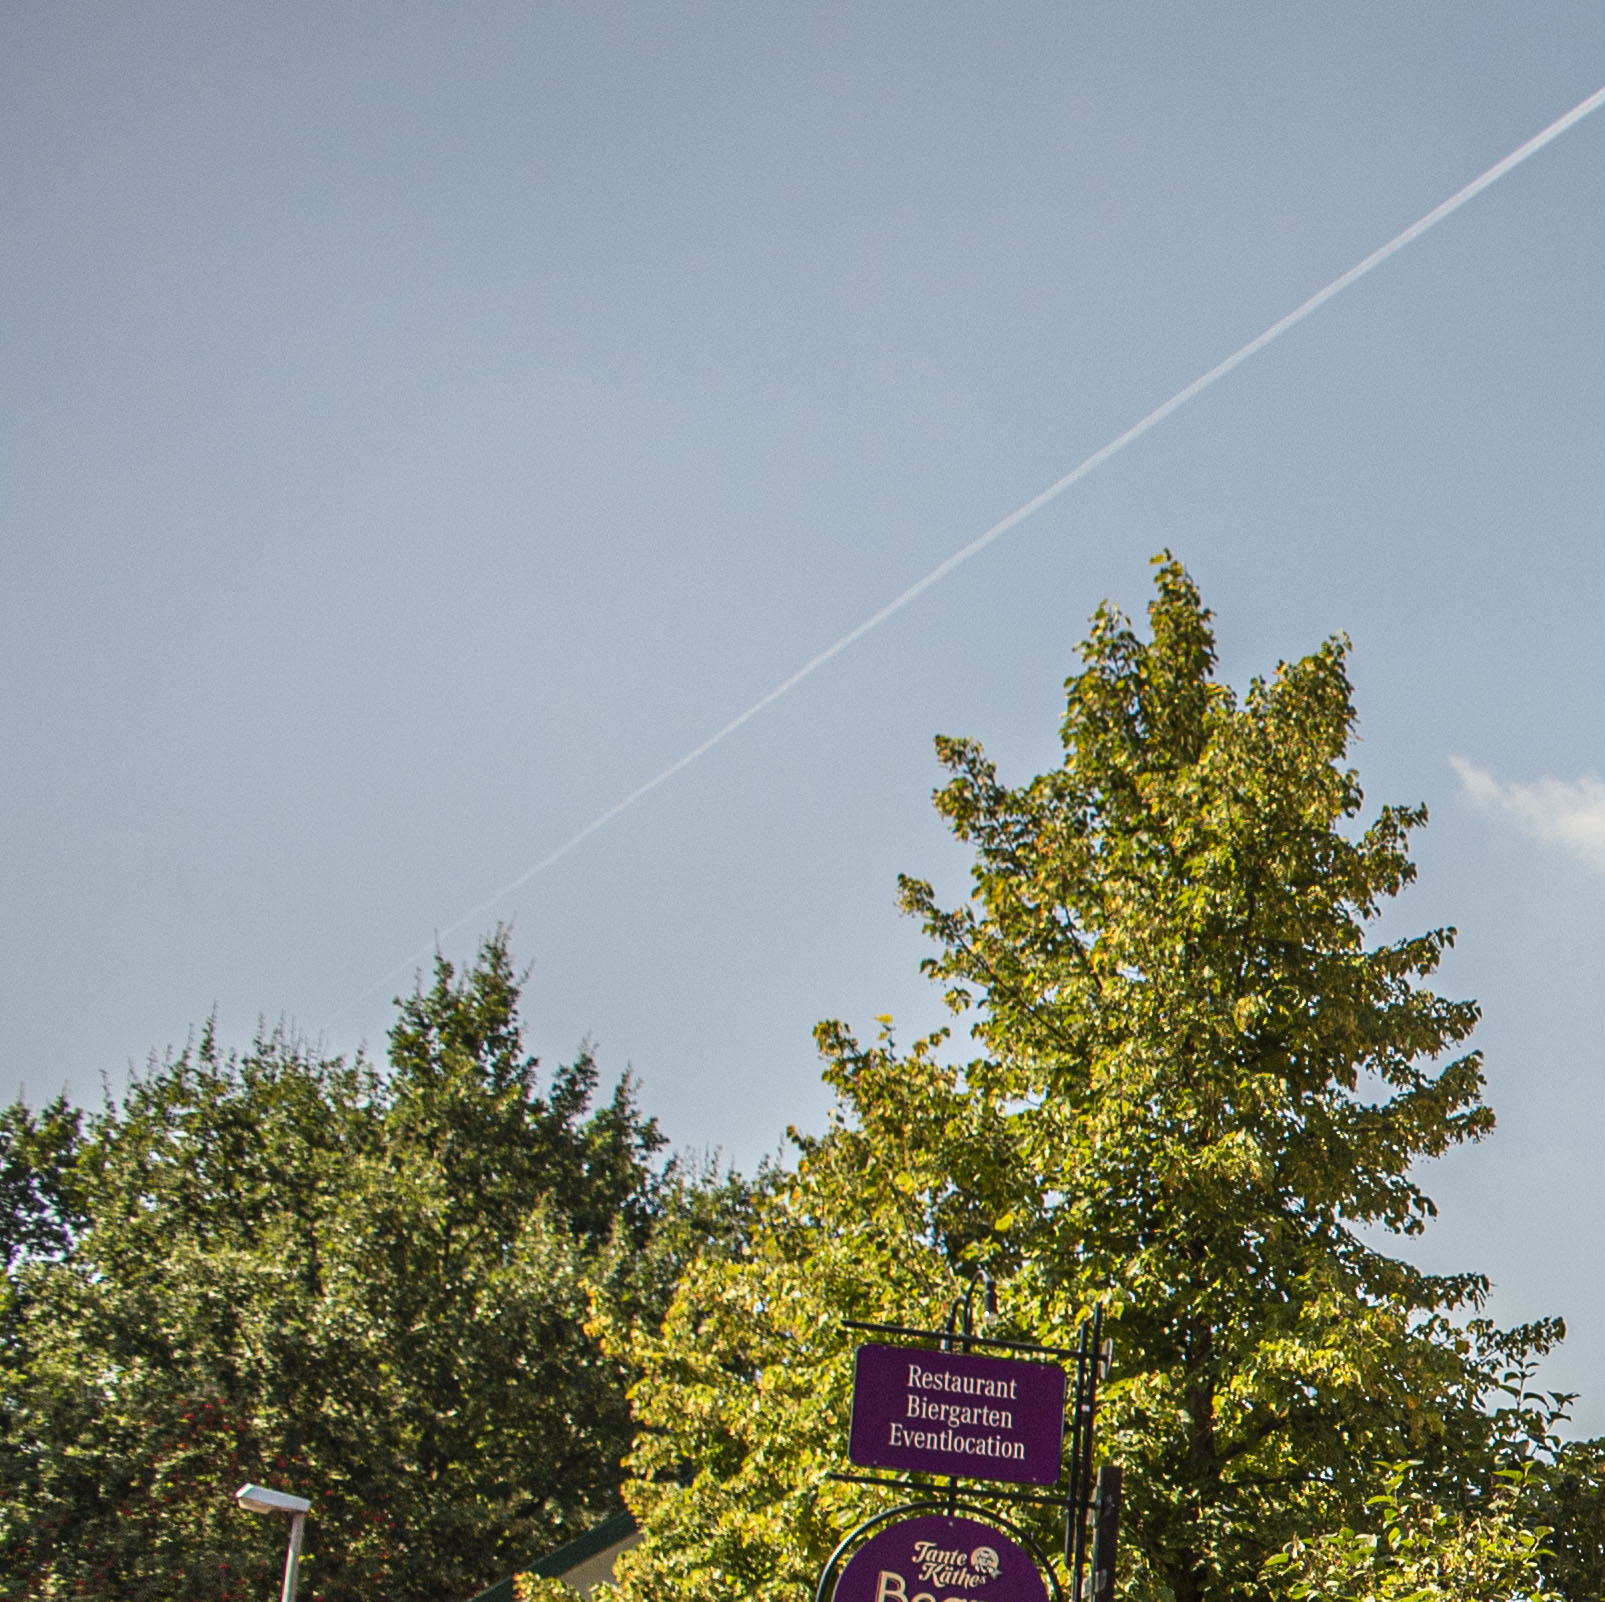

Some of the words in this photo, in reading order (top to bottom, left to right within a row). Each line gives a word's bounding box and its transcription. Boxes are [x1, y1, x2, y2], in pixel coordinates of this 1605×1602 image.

[907, 1364, 1018, 1400] Restaurant
[906, 1394, 1013, 1429] Biergarten
[888, 1422, 1026, 1460] Eventlocation
[911, 1541, 968, 1567] Tante
